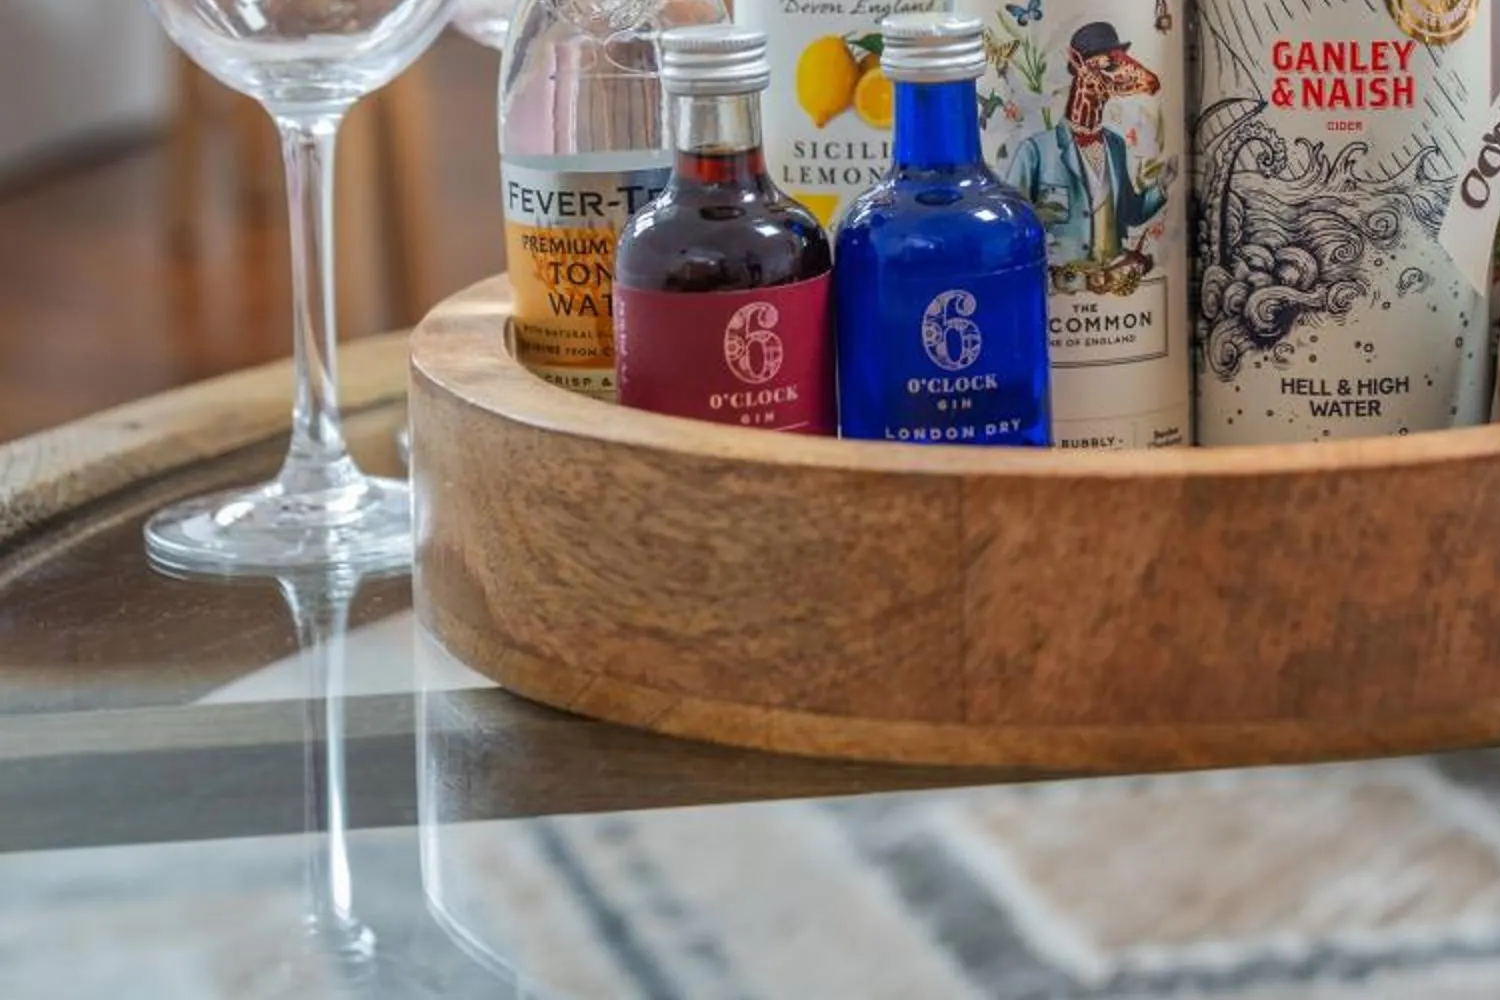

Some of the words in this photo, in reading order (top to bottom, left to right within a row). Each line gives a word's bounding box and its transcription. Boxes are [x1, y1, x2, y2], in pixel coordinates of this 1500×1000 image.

[1271, 41, 1416, 74] GANLEY
[1271, 77, 1294, 107] &
[1302, 77, 1415, 109] NAISH
[1327, 120, 1363, 132] CIDER
[522, 235, 609, 255] PREMIUM
[1072, 303, 1098, 313] THE
[921, 289, 982, 371] 6
[724, 301, 784, 385] 6
[1085, 334, 1136, 347] ENGLAND
[907, 373, 998, 394] O'CLOCK
[1281, 377, 1332, 396] HELL
[1337, 379, 1352, 395] &
[1357, 376, 1410, 394] HIGH
[709, 385, 798, 410] O'CLOCK
[937, 399, 972, 411] GIN
[1309, 399, 1382, 417] WATER
[885, 424, 975, 440] LONDON
[985, 418, 1022, 436] DRY
[1061, 435, 1116, 449] BUBBLY
